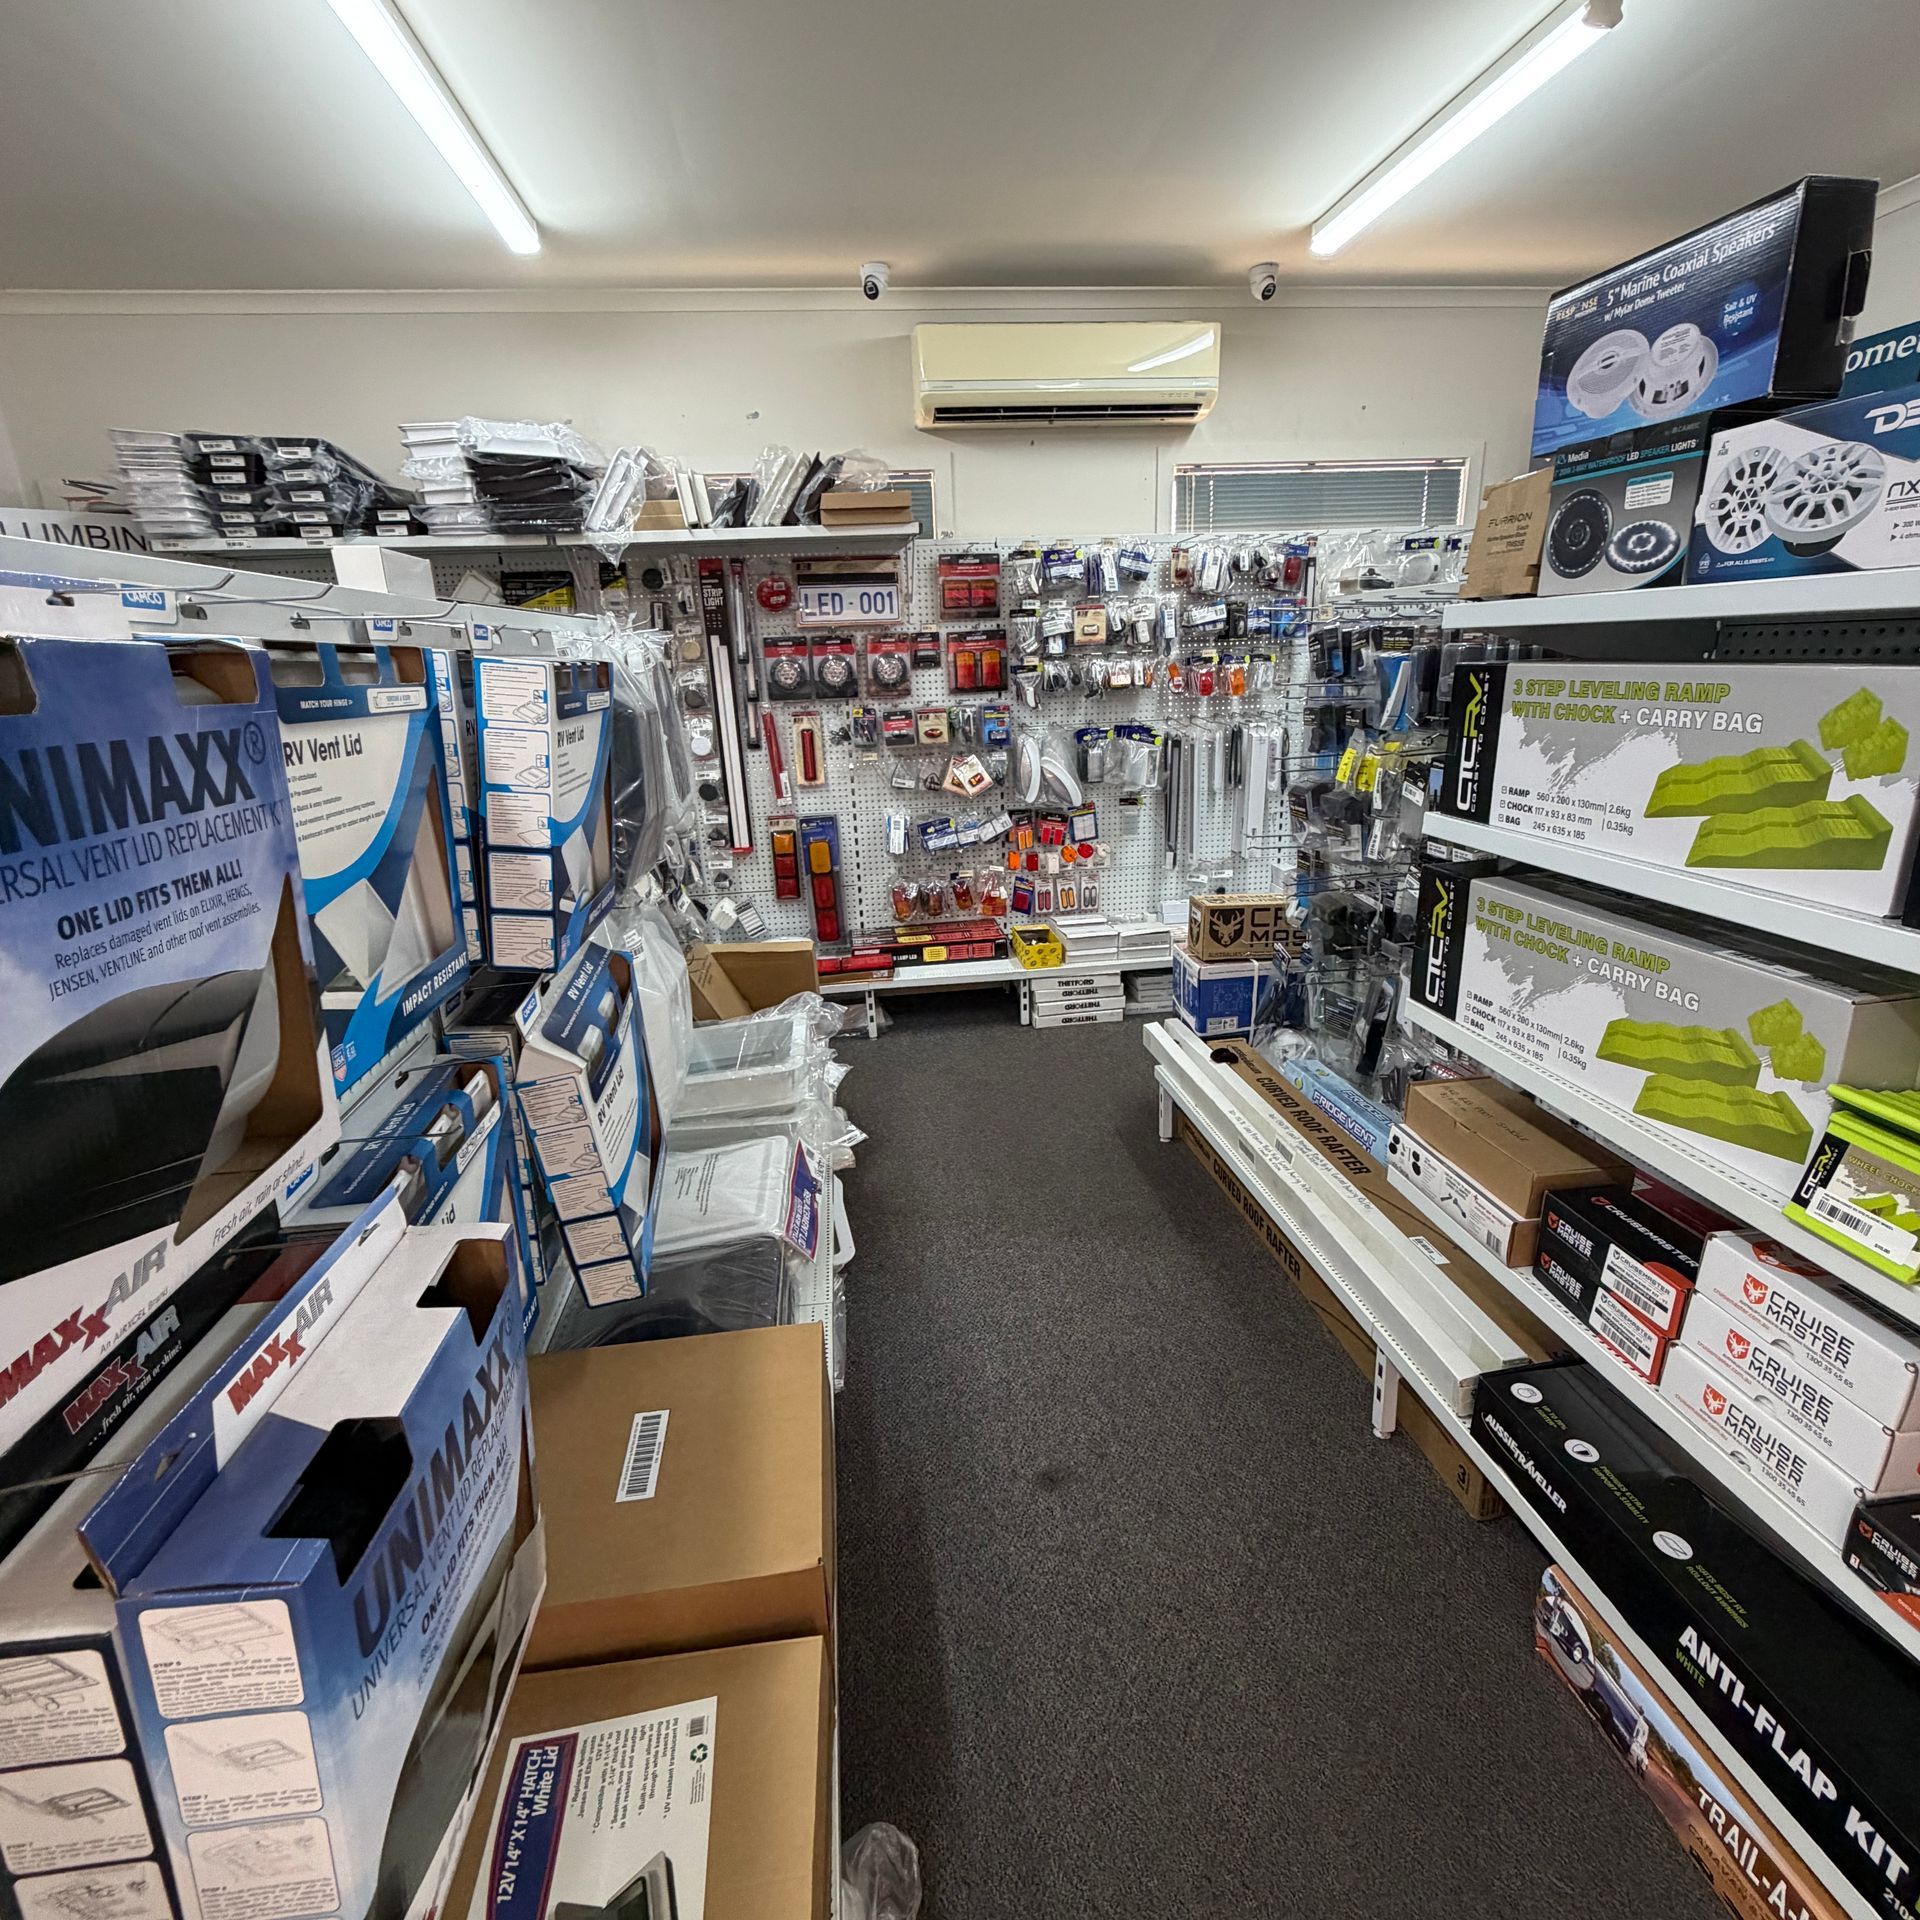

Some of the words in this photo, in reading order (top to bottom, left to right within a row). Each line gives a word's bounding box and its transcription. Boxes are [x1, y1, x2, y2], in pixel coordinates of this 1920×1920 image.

[1620, 271, 1659, 301] Marine
[1663, 249, 1708, 282] Coaxial
[1712, 224, 1775, 264] Speakers
[1635, 293, 1656, 310] Dome
[1656, 282, 1685, 303] Tweeter
[1627, 452, 1639, 462] LED
[1671, 440, 1696, 452] LIGHTS
[1488, 511, 1533, 527] FURRION
[703, 589, 723, 598] STRIP
[704, 597, 724, 607] LIGHT
[804, 593, 843, 617] LED
[859, 590, 894, 614] 001
[1513, 679, 1523, 696] 3
[1526, 679, 1565, 697] STEP
[1569, 680, 1660, 701] LEVELING
[1664, 683, 1731, 704] RAMP
[557, 731, 565, 748] RV
[565, 728, 576, 744] Vent
[1512, 701, 1552, 719] WITH
[1554, 703, 1617, 723] CHOCK
[1636, 708, 1708, 732] CARRY
[1711, 711, 1763, 735] BAG
[285, 741, 303, 767] RV
[308, 737, 341, 763] Vent
[346, 733, 363, 758] Lid
[1507, 801, 1533, 815] CHOCK
[1535, 807, 1544, 816] 117
[1551, 809, 1560, 820] 93
[1567, 812, 1576, 823] 83
[1578, 817, 1592, 826] mm
[1606, 821, 1634, 837] 0.35kg
[1508, 787, 1530, 798] RAMP
[1537, 791, 1550, 803] 560
[1557, 795, 1569, 806] 200
[1609, 803, 1631, 819] 2.6kg
[73, 838, 130, 882] VENT
[132, 831, 163, 868] LID
[167, 809, 270, 857] REPLACEMENT
[1505, 815, 1520, 826] BAG
[1533, 821, 1546, 832] 245
[1552, 825, 1566, 836] 635
[1573, 829, 1585, 840] 185
[57, 906, 103, 941] ONE
[104, 896, 134, 925] LID
[135, 883, 171, 914] FITS
[172, 871, 213, 900] THEM
[216, 859, 243, 886] ALL!
[55, 942, 107, 970] Replaces
[109, 923, 152, 950] damaged
[153, 915, 172, 932] vent
[173, 906, 189, 925] lids
[190, 904, 200, 919] on
[201, 894, 226, 913] ELIXIR,
[1477, 897, 1485, 912] 3
[1488, 901, 1524, 924] STEP
[1527, 913, 1608, 955] LEVELING
[1612, 941, 1671, 974] RAMP
[50, 969, 99, 1002] JENSEN,
[99, 948, 147, 980] VENTLINE
[147, 941, 165, 959] and
[165, 932, 188, 952] other
[188, 921, 205, 942] roof
[204, 916, 222, 934] vent
[1476, 915, 1511, 941] WITH
[1513, 929, 1569, 963] CHOCK
[1587, 957, 1652, 993] CARRY
[1655, 983, 1700, 1012] BAG
[402, 981, 431, 1017] IMPACT
[434, 952, 468, 989] RESISTANT
[568, 984, 580, 1000] RV
[573, 972, 589, 990] Vent
[1471, 1018, 1485, 1031] BAG
[1496, 1032, 1508, 1045] 245
[1514, 1040, 1526, 1053] 635
[1532, 1049, 1544, 1061] 185
[1472, 1006, 1496, 1024] CHOCK
[1562, 1050, 1587, 1070] 0.35kg
[1473, 993, 1493, 1007] RAMP
[1564, 1036, 1585, 1054] 2.6kg
[597, 1105, 608, 1127] RV
[604, 1083, 617, 1110] Vent
[615, 1064, 625, 1085] Lid
[1256, 1077, 1300, 1109] CURVED
[1290, 1110, 1328, 1134] ROOF
[1317, 1135, 1371, 1174] RAFTER
[1313, 1089, 1347, 1125] FRIDGE
[1347, 1118, 1376, 1147] VENT
[213, 1211, 237, 1247] Fresh
[238, 1198, 253, 1225] air,
[254, 1183, 272, 1206] rain
[1213, 1159, 1240, 1204] CURVED
[1243, 1197, 1264, 1231] ROOF
[1266, 1224, 1300, 1280] RAFTER
[1559, 1219, 1596, 1248] CRUISE
[1556, 1229, 1592, 1258] MASTER
[1549, 1269, 1581, 1299] MASTER
[1550, 1259, 1585, 1291] CRUISE
[1765, 1304, 1851, 1369] MASTER
[1769, 1290, 1855, 1350] CRUISE
[161, 1339, 184, 1373] shine!
[1751, 1346, 1834, 1406] CRUISE
[1806, 1352, 1823, 1369] 1300
[1748, 1360, 1829, 1428] MASTER
[1728, 1403, 1808, 1468] CRUISE
[1787, 1409, 1804, 1425] 1300
[1724, 1416, 1804, 1487] MASTER
[1762, 1466, 1779, 1483] 1300
[421, 1593, 442, 1635] ONE
[442, 1555, 458, 1594] LID
[457, 1515, 475, 1559] FITS
[475, 1472, 496, 1517] THEM
[1870, 1538, 1917, 1580] MASTER
[1872, 1531, 1920, 1573] CRUISE
[351, 1558, 430, 1720] UNIVERSAL
[427, 1506, 452, 1562] VENT
[452, 1472, 471, 1512] LID
[1675, 1648, 1706, 1688] WHITE
[541, 1746, 560, 1768] Lid
[669, 1727, 679, 1768] translucent
[1678, 1625, 1838, 1801] ANTI-FLAP
[1844, 1805, 1910, 1886] KIT
[531, 1770, 554, 1817] White
[572, 1768, 583, 1803] Replaces
[624, 1770, 633, 1802] resistant
[648, 1768, 659, 1799] through
[666, 1767, 675, 1801] resistant
[578, 1791, 588, 1818] Jensen
[592, 1785, 605, 1829] Compatible
[497, 1871, 516, 1903] 12V
[520, 1749, 543, 1799] HATCH
